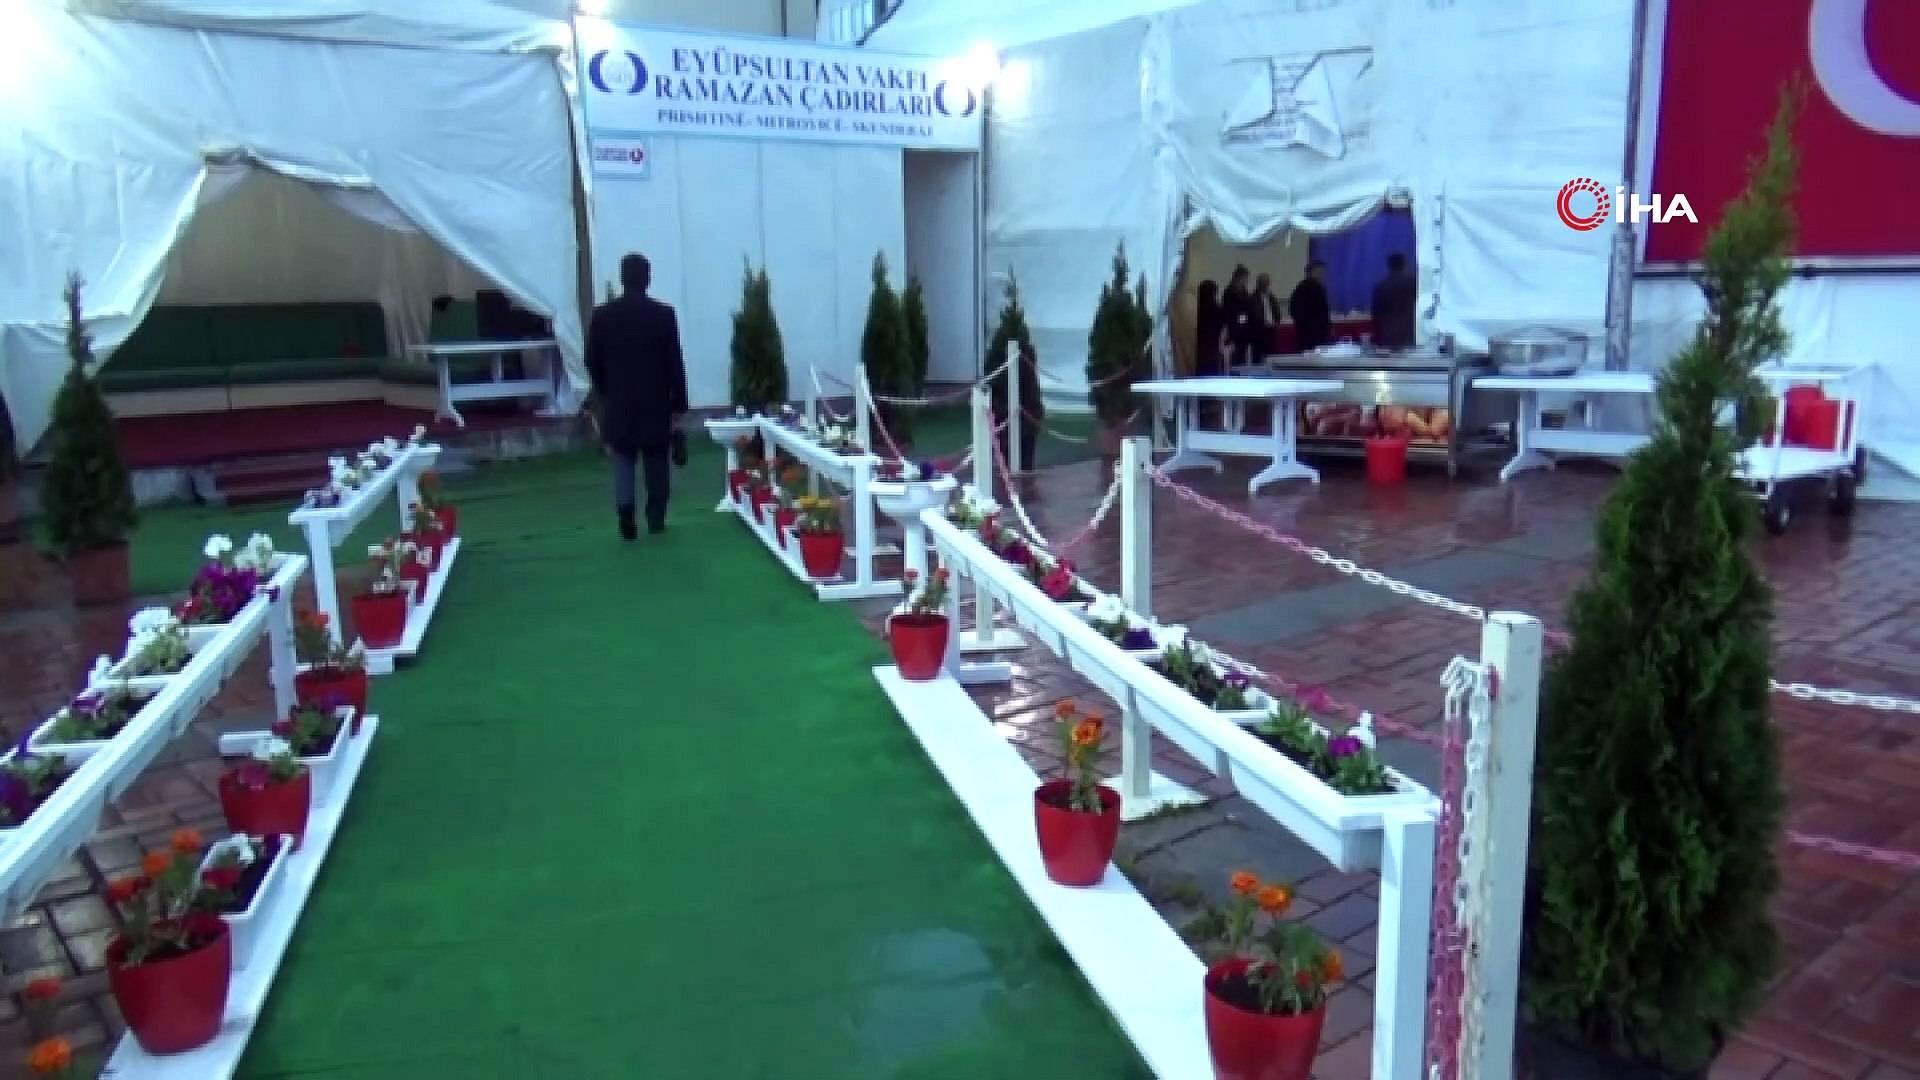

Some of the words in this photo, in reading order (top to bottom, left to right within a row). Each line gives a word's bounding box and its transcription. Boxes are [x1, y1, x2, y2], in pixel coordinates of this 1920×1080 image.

[672, 46, 849, 84] EYÜPSULTAN
[855, 64, 928, 92] VAKFI
[656, 75, 793, 107] RAMAZAN
[800, 86, 932, 116] ÇADIRLARI
